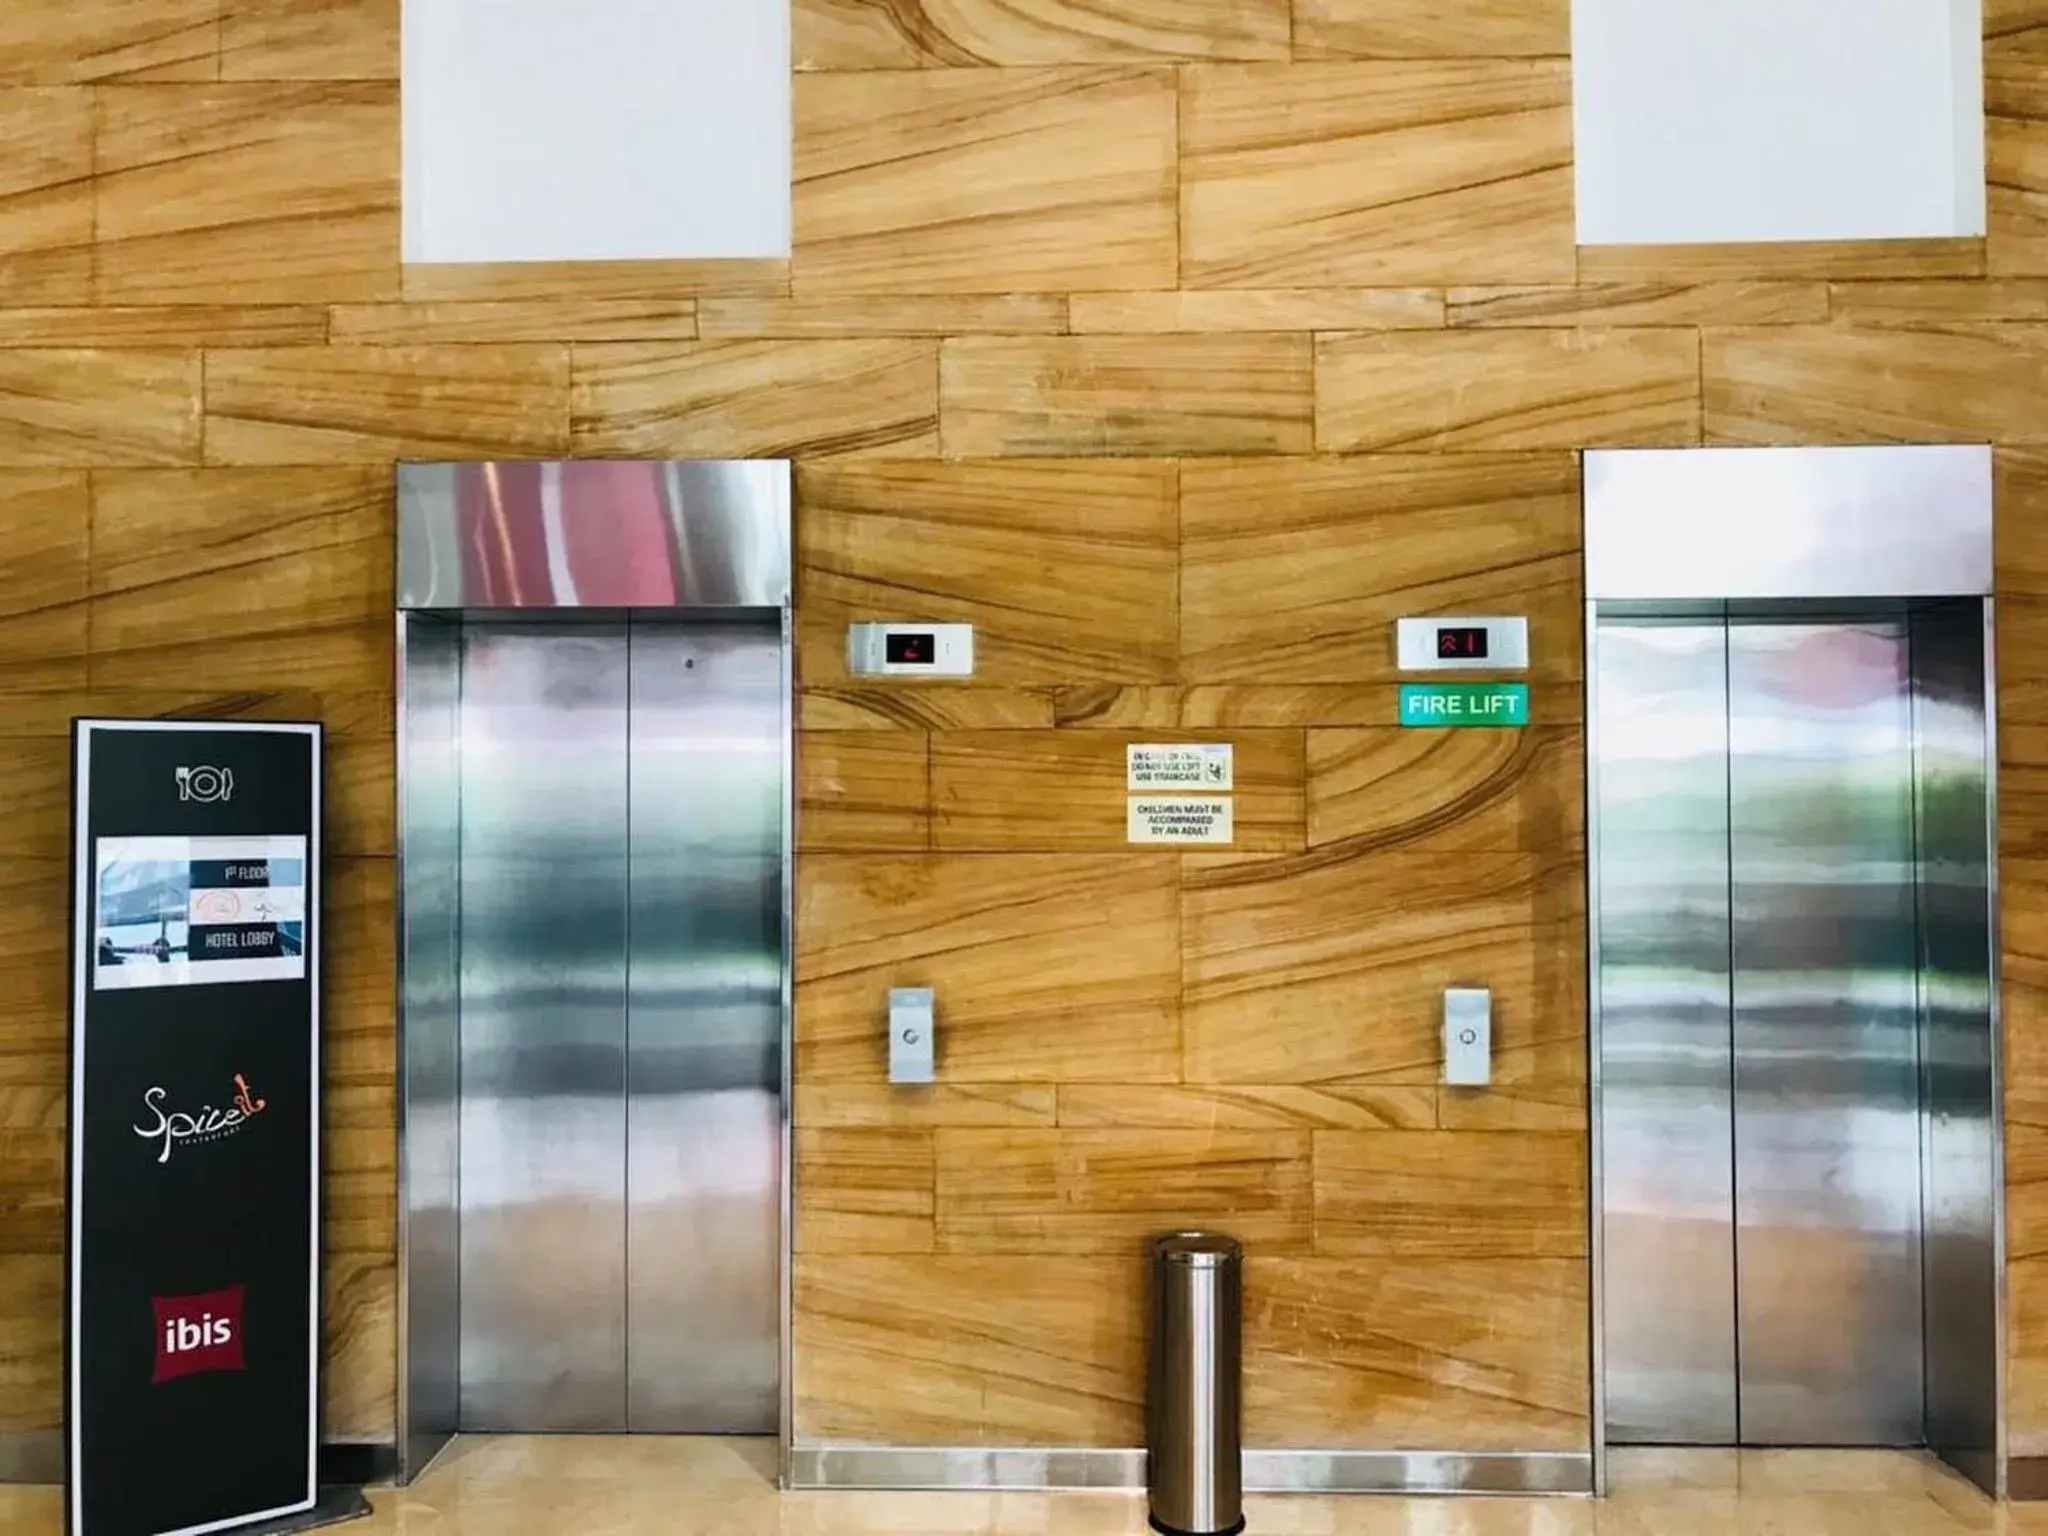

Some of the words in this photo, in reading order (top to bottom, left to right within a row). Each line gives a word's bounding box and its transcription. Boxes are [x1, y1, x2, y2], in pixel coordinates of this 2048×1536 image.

[1408, 695, 1462, 715] FIRE
[1469, 694, 1520, 715] LIFT
[1137, 804, 1182, 814] CHILDREN
[1184, 804, 1209, 814] MUST
[1211, 804, 1223, 814] BE
[1148, 815, 1214, 825] ACCOMPANIED
[1151, 826, 1163, 835] BY
[1164, 826, 1180, 835] AN
[1180, 826, 1209, 836] ADULT
[205, 931, 239, 949] HOTEL
[241, 930, 275, 947] LOBBY
[166, 1312, 231, 1354] ibis
